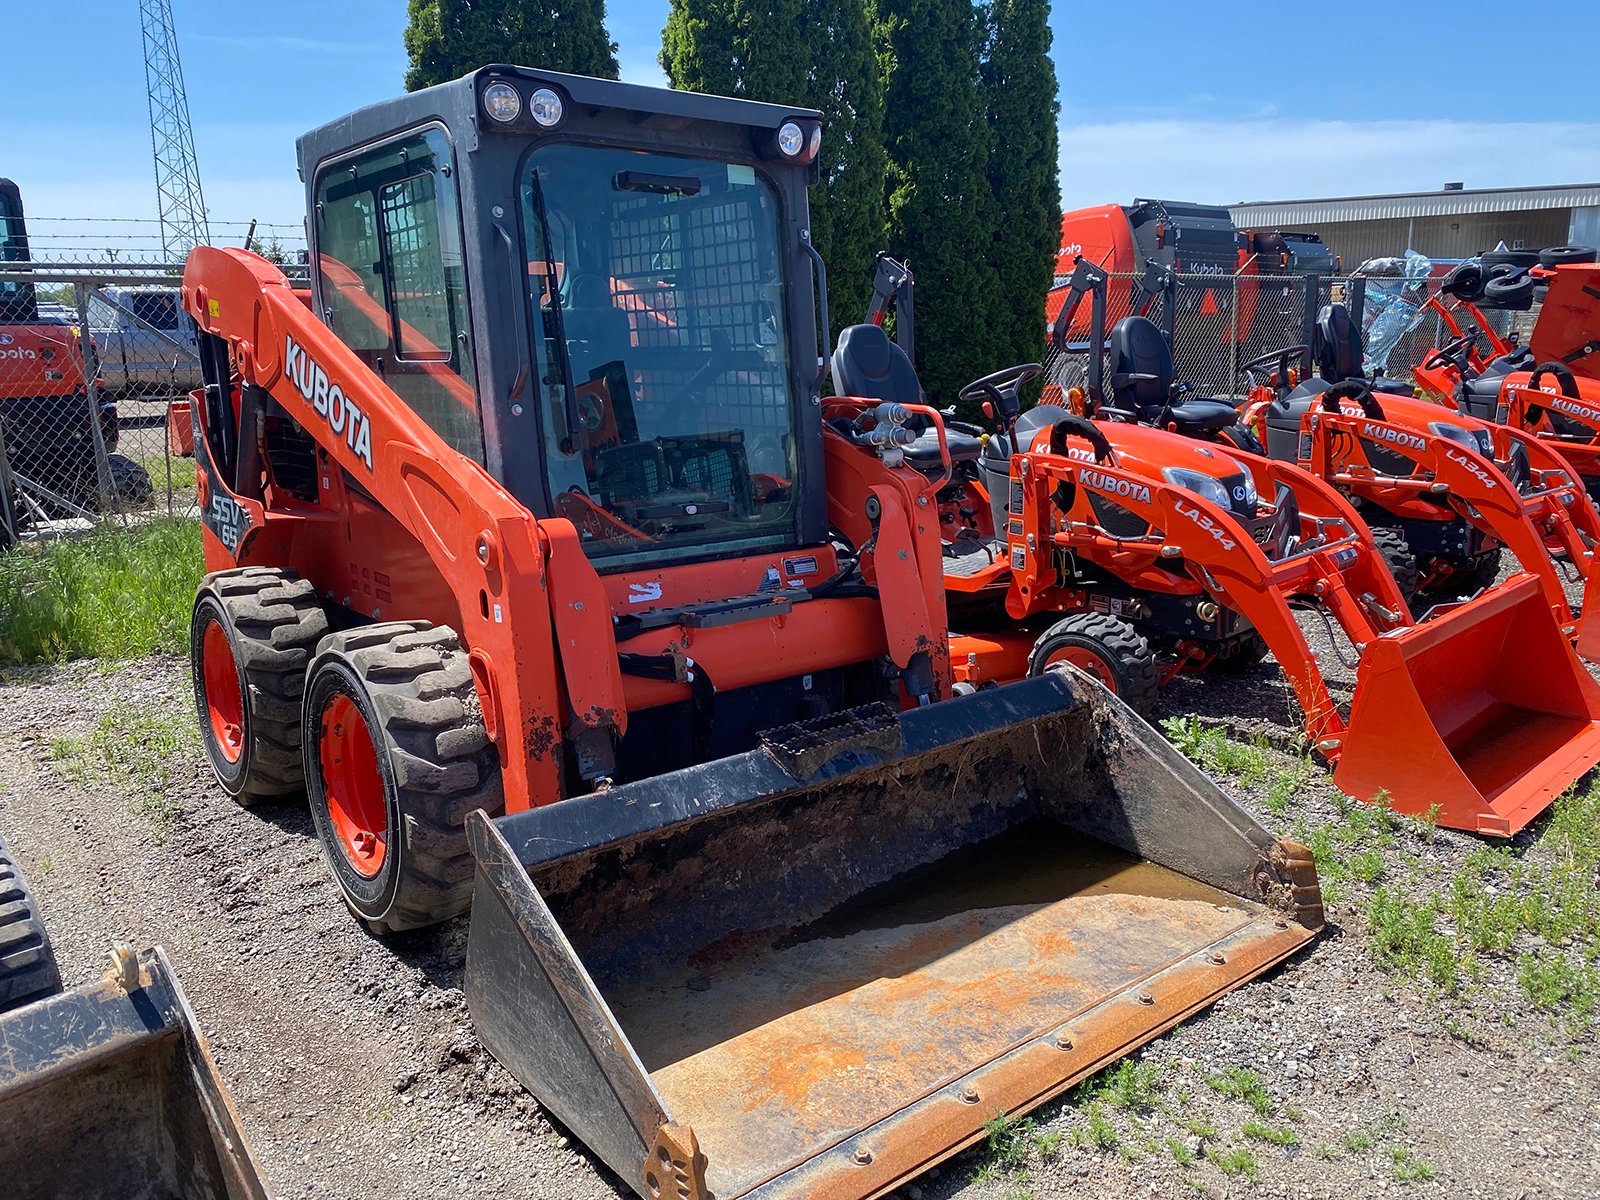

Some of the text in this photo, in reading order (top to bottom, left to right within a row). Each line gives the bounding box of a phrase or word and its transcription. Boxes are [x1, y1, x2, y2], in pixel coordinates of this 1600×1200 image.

[1190, 262, 1224, 276] Kubota
[285, 334, 373, 471] KUBOTA
[1551, 397, 1600, 421] KUBOT
[1363, 422, 1428, 452] KUBOTA
[1445, 449, 1498, 489] LA344
[1079, 468, 1153, 505] KUBOTA
[212, 494, 240, 526] SSV
[1174, 500, 1238, 551] LA344
[222, 524, 238, 549] 65
